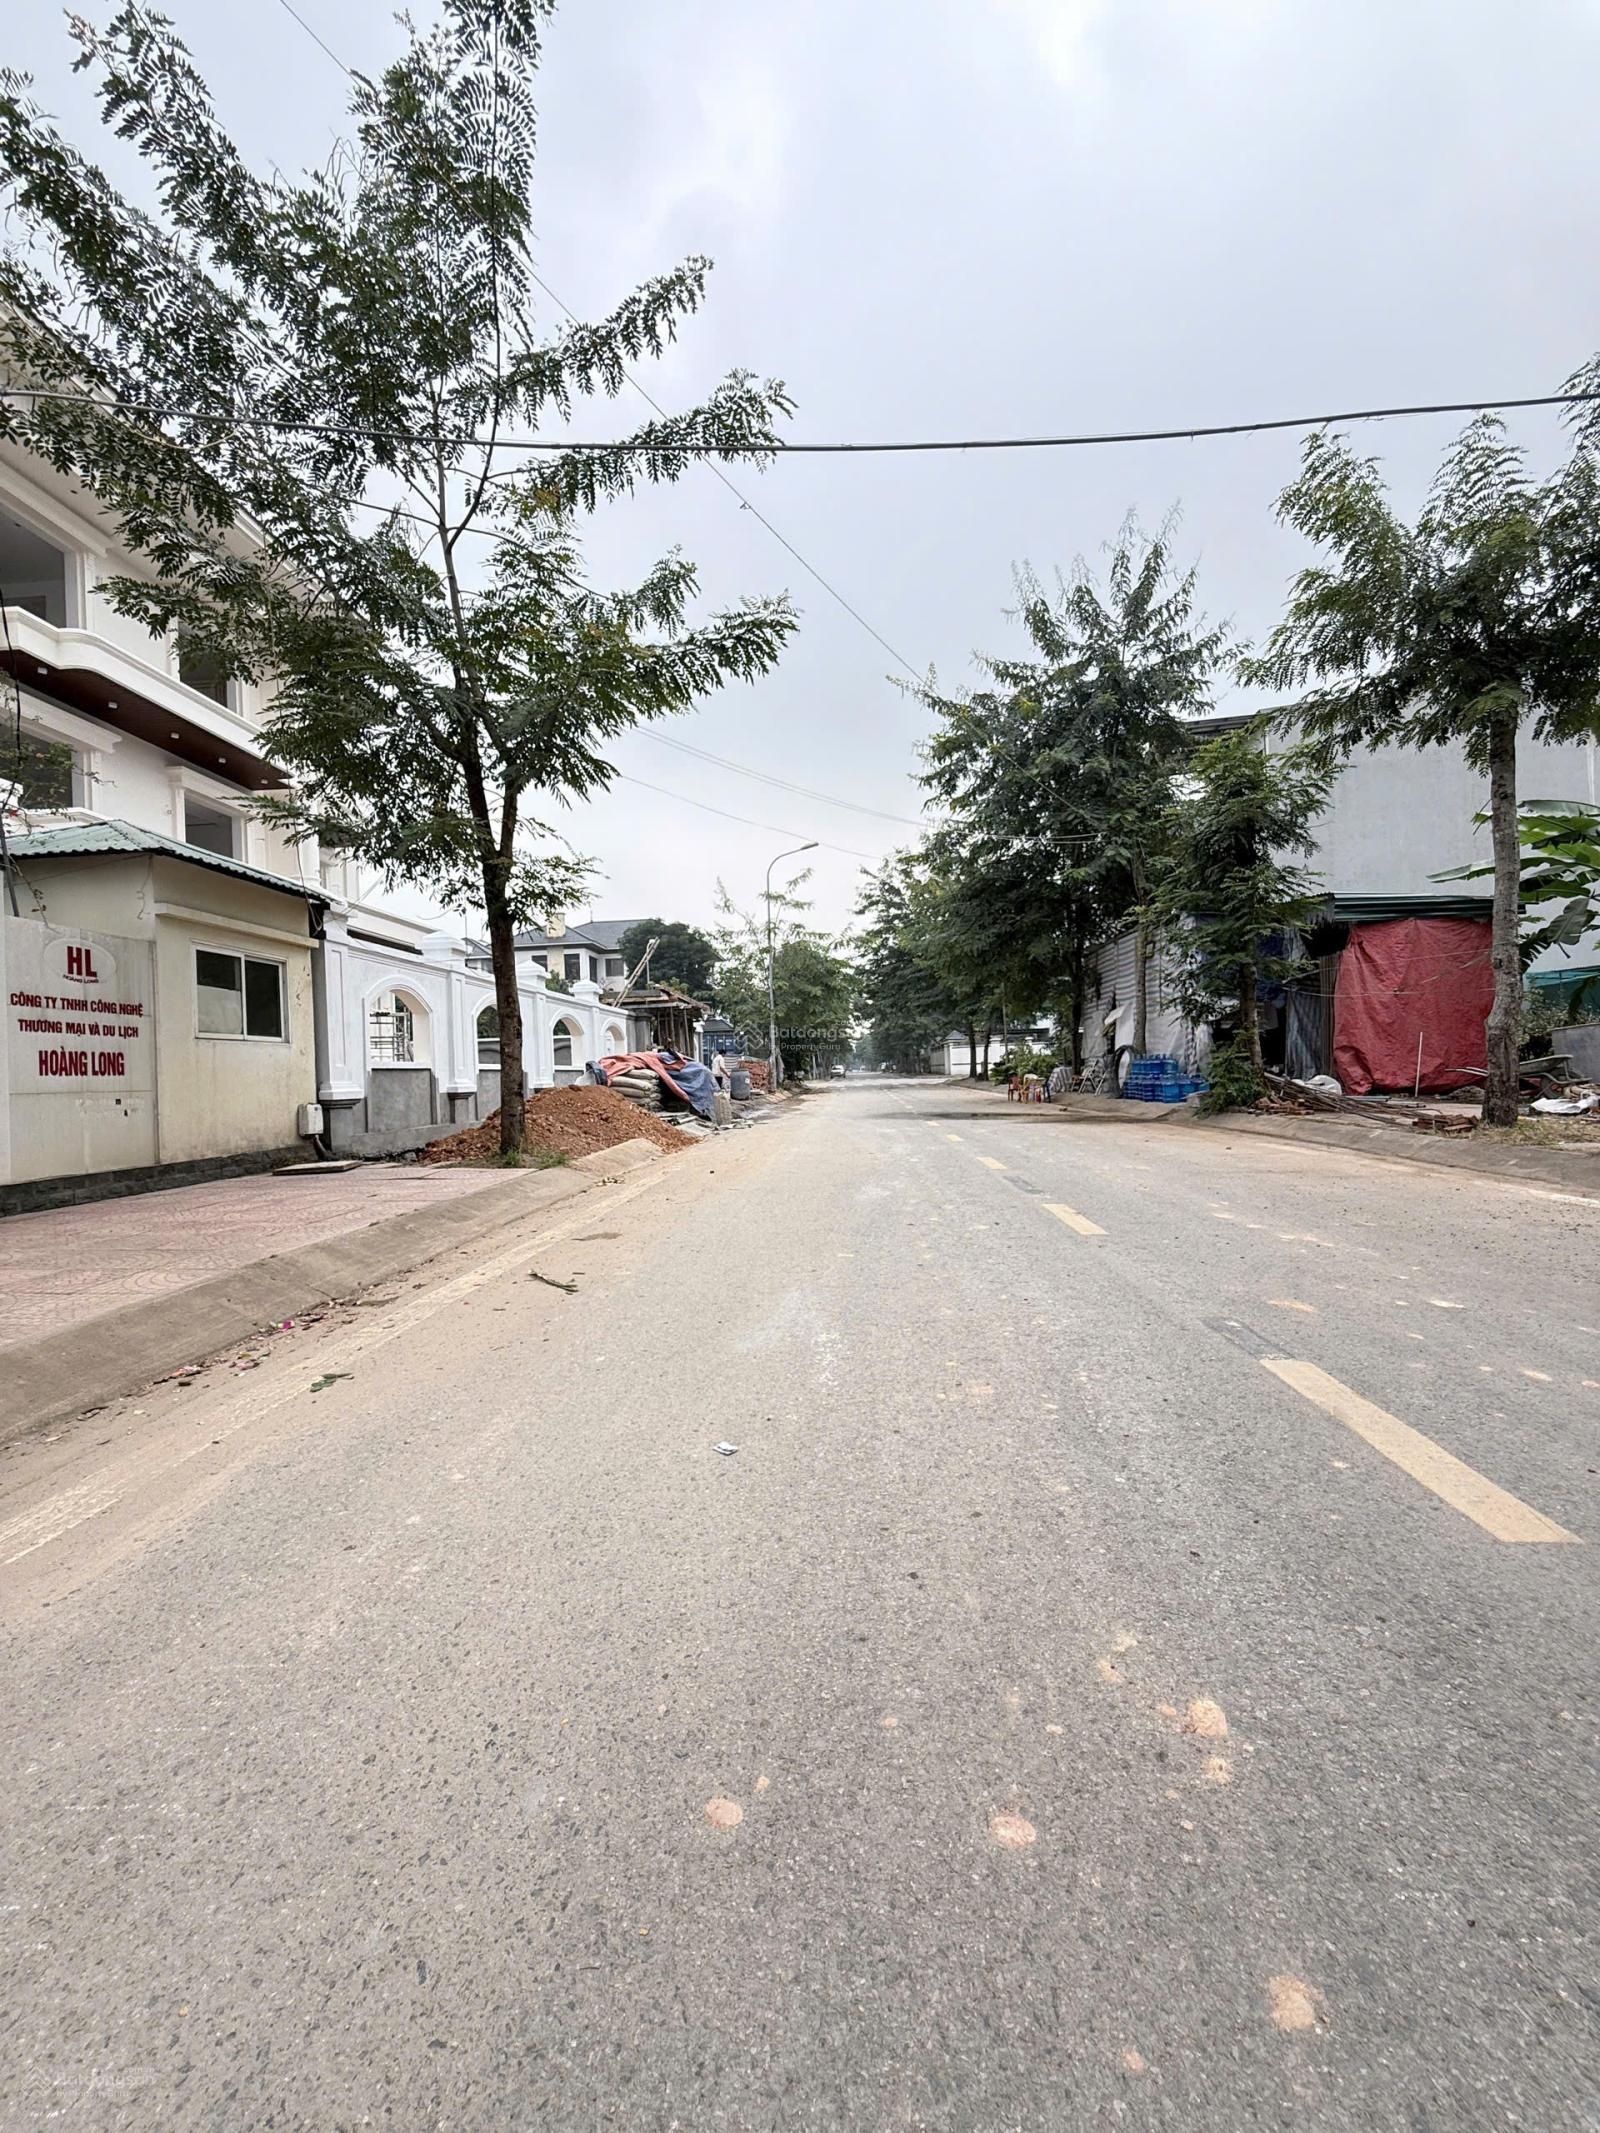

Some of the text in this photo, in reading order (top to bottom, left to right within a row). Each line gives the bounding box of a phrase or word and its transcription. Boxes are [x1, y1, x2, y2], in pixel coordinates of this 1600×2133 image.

[67, 946, 98, 977] HL
[10, 992, 144, 1018] CÔNG TY TNHH CÔNG NGHỆ
[18, 1019, 139, 1040] THƯƠNG MẠI VÀ DU LỊCH
[38, 1046, 125, 1077] HOÀNG LONG
